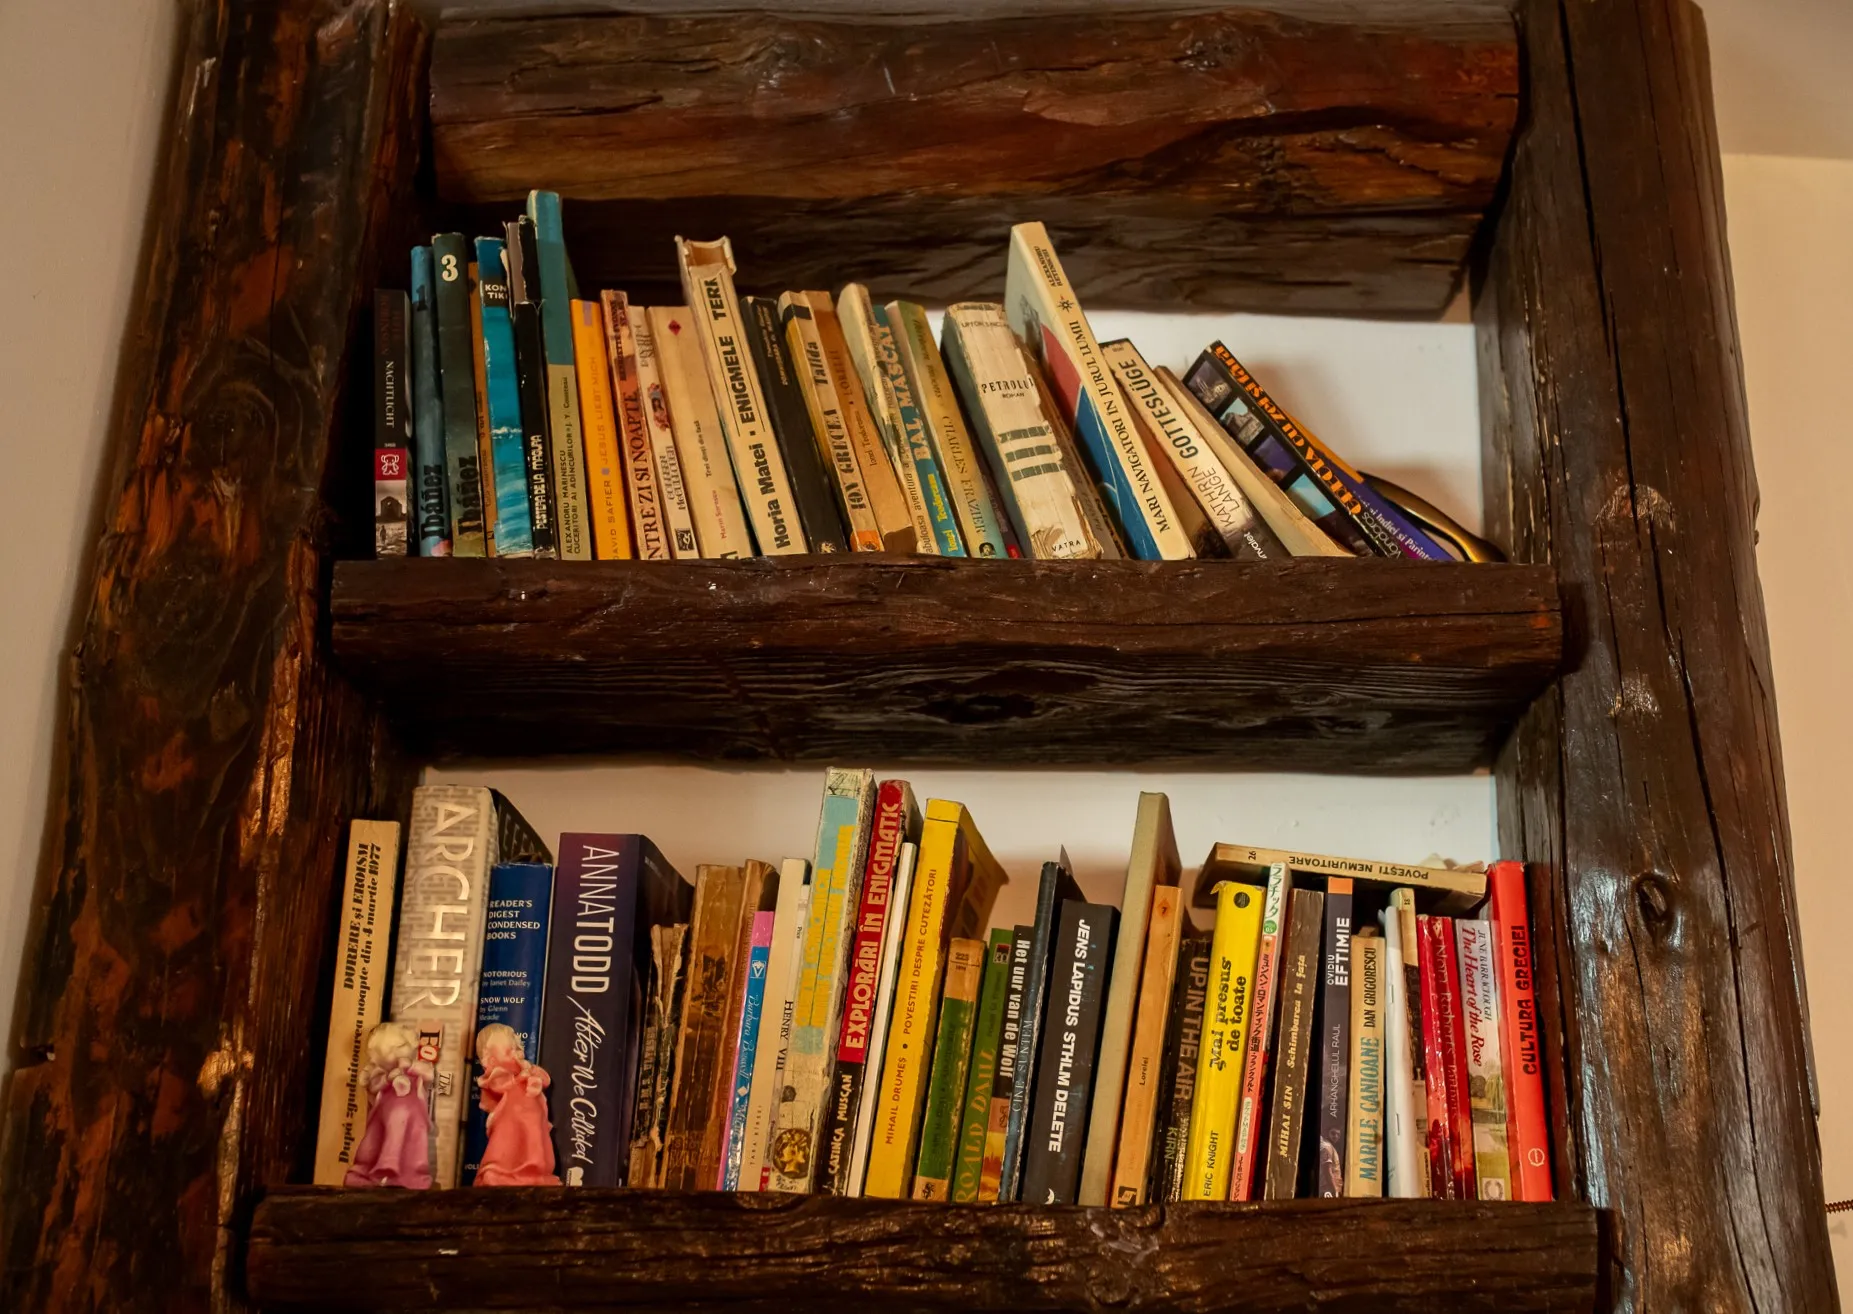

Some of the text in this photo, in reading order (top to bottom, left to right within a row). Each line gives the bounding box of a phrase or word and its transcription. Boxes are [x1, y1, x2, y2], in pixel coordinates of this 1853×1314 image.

[441, 254, 459, 281] 3
[484, 283, 506, 291] KON
[1068, 319, 1092, 357] LUMII
[385, 361, 394, 427] NACHTLICHT
[718, 333, 755, 424] ENIGMELE
[1084, 354, 1112, 399] JURUL
[597, 424, 607, 465] JESUS
[622, 389, 647, 462] NOAPTE
[904, 416, 932, 462] BAL
[1115, 352, 1235, 530] KATHRIN GOTTESLÜGE
[1280, 420, 1306, 448] cu
[703, 462, 711, 477] Trei
[748, 440, 775, 495] Matei
[940, 414, 987, 534] CHARLES FRAZIER
[1109, 417, 1154, 494] NAVIGATORI
[420, 464, 443, 539] Ibáñez
[559, 450, 572, 553] ALEXANDRU MARINESCU
[570, 492, 576, 500] AI
[603, 480, 615, 523] SAFIER
[636, 484, 653, 504] ZI
[844, 480, 866, 512] ION
[1201, 463, 1239, 514] LANGE
[571, 505, 580, 553] CUCERITORI
[764, 497, 790, 548] Horia
[916, 514, 933, 554] abuloasa
[1144, 495, 1170, 532] MARI
[1375, 511, 1400, 535] Indiei
[1051, 538, 1080, 551] VATRA
[1242, 530, 1267, 561] nvalet
[366, 843, 380, 875] 1977
[866, 801, 899, 906] ENIGMATIC
[1247, 850, 1257, 860] 26
[1289, 855, 1373, 875] NEMURITOARE
[342, 920, 359, 988] DURERE
[351, 843, 368, 904] EROISM
[365, 878, 378, 925] martie
[403, 802, 478, 1011] ARCHER
[489, 900, 532, 908] READER'S
[489, 910, 520, 919] DIGEST
[860, 911, 883, 933] ÎN
[362, 928, 372, 937] 4
[486, 932, 516, 940] BOOKS
[488, 921, 540, 930] CONDENSED
[1477, 929, 1486, 954] JUNE
[359, 940, 371, 962] din
[1187, 955, 1208, 988] UP
[1326, 954, 1335, 985] OVIDIU
[1334, 917, 1350, 985] EFTIMIE
[1436, 945, 1448, 983] Nora
[356, 967, 371, 1015] noapte
[508, 980, 531, 988] Dailey
[1184, 988, 1204, 1012] IN
[1215, 956, 1232, 1024] presus
[1462, 927, 1485, 1068] The Heart of the Rose
[1510, 924, 1536, 1074] CULTURA GRECIEI
[743, 995, 759, 1036] Barbara
[999, 939, 1030, 1078] Het uur van de Wolf
[1225, 975, 1245, 1051] de toate
[775, 1000, 793, 1071] HENRY VIII
[884, 1104, 898, 1144] MIHAIL
[903, 980, 918, 1034] POVESTIRI
[912, 938, 925, 977] DESPRE
[1048, 918, 1091, 1153] JENS LAPIDUS STHLM DELETE
[1179, 1013, 1201, 1058] THE
[342, 1018, 368, 1118] zguduitoarea
[564, 995, 606, 1163] After We Collided
[1011, 1019, 1032, 1112] CINE SUNTEM
[1138, 1056, 1148, 1085] Lorelei
[1173, 1061, 1194, 1100] AIR
[1279, 982, 1302, 1157] MIHAI SIN Schimbarea la
[1329, 1023, 1340, 1117] ARHANGHELUL RAUL
[1357, 947, 1379, 1180] MARILE CANIOANE DAN GRIGORESCU
[954, 1120, 985, 1203] ROALD
[970, 1047, 995, 1112] DAHL
[1163, 1126, 1177, 1159] KIRN
[827, 1126, 844, 1175] CATINCA
[1203, 1130, 1218, 1196] ERIC KNIGHT
